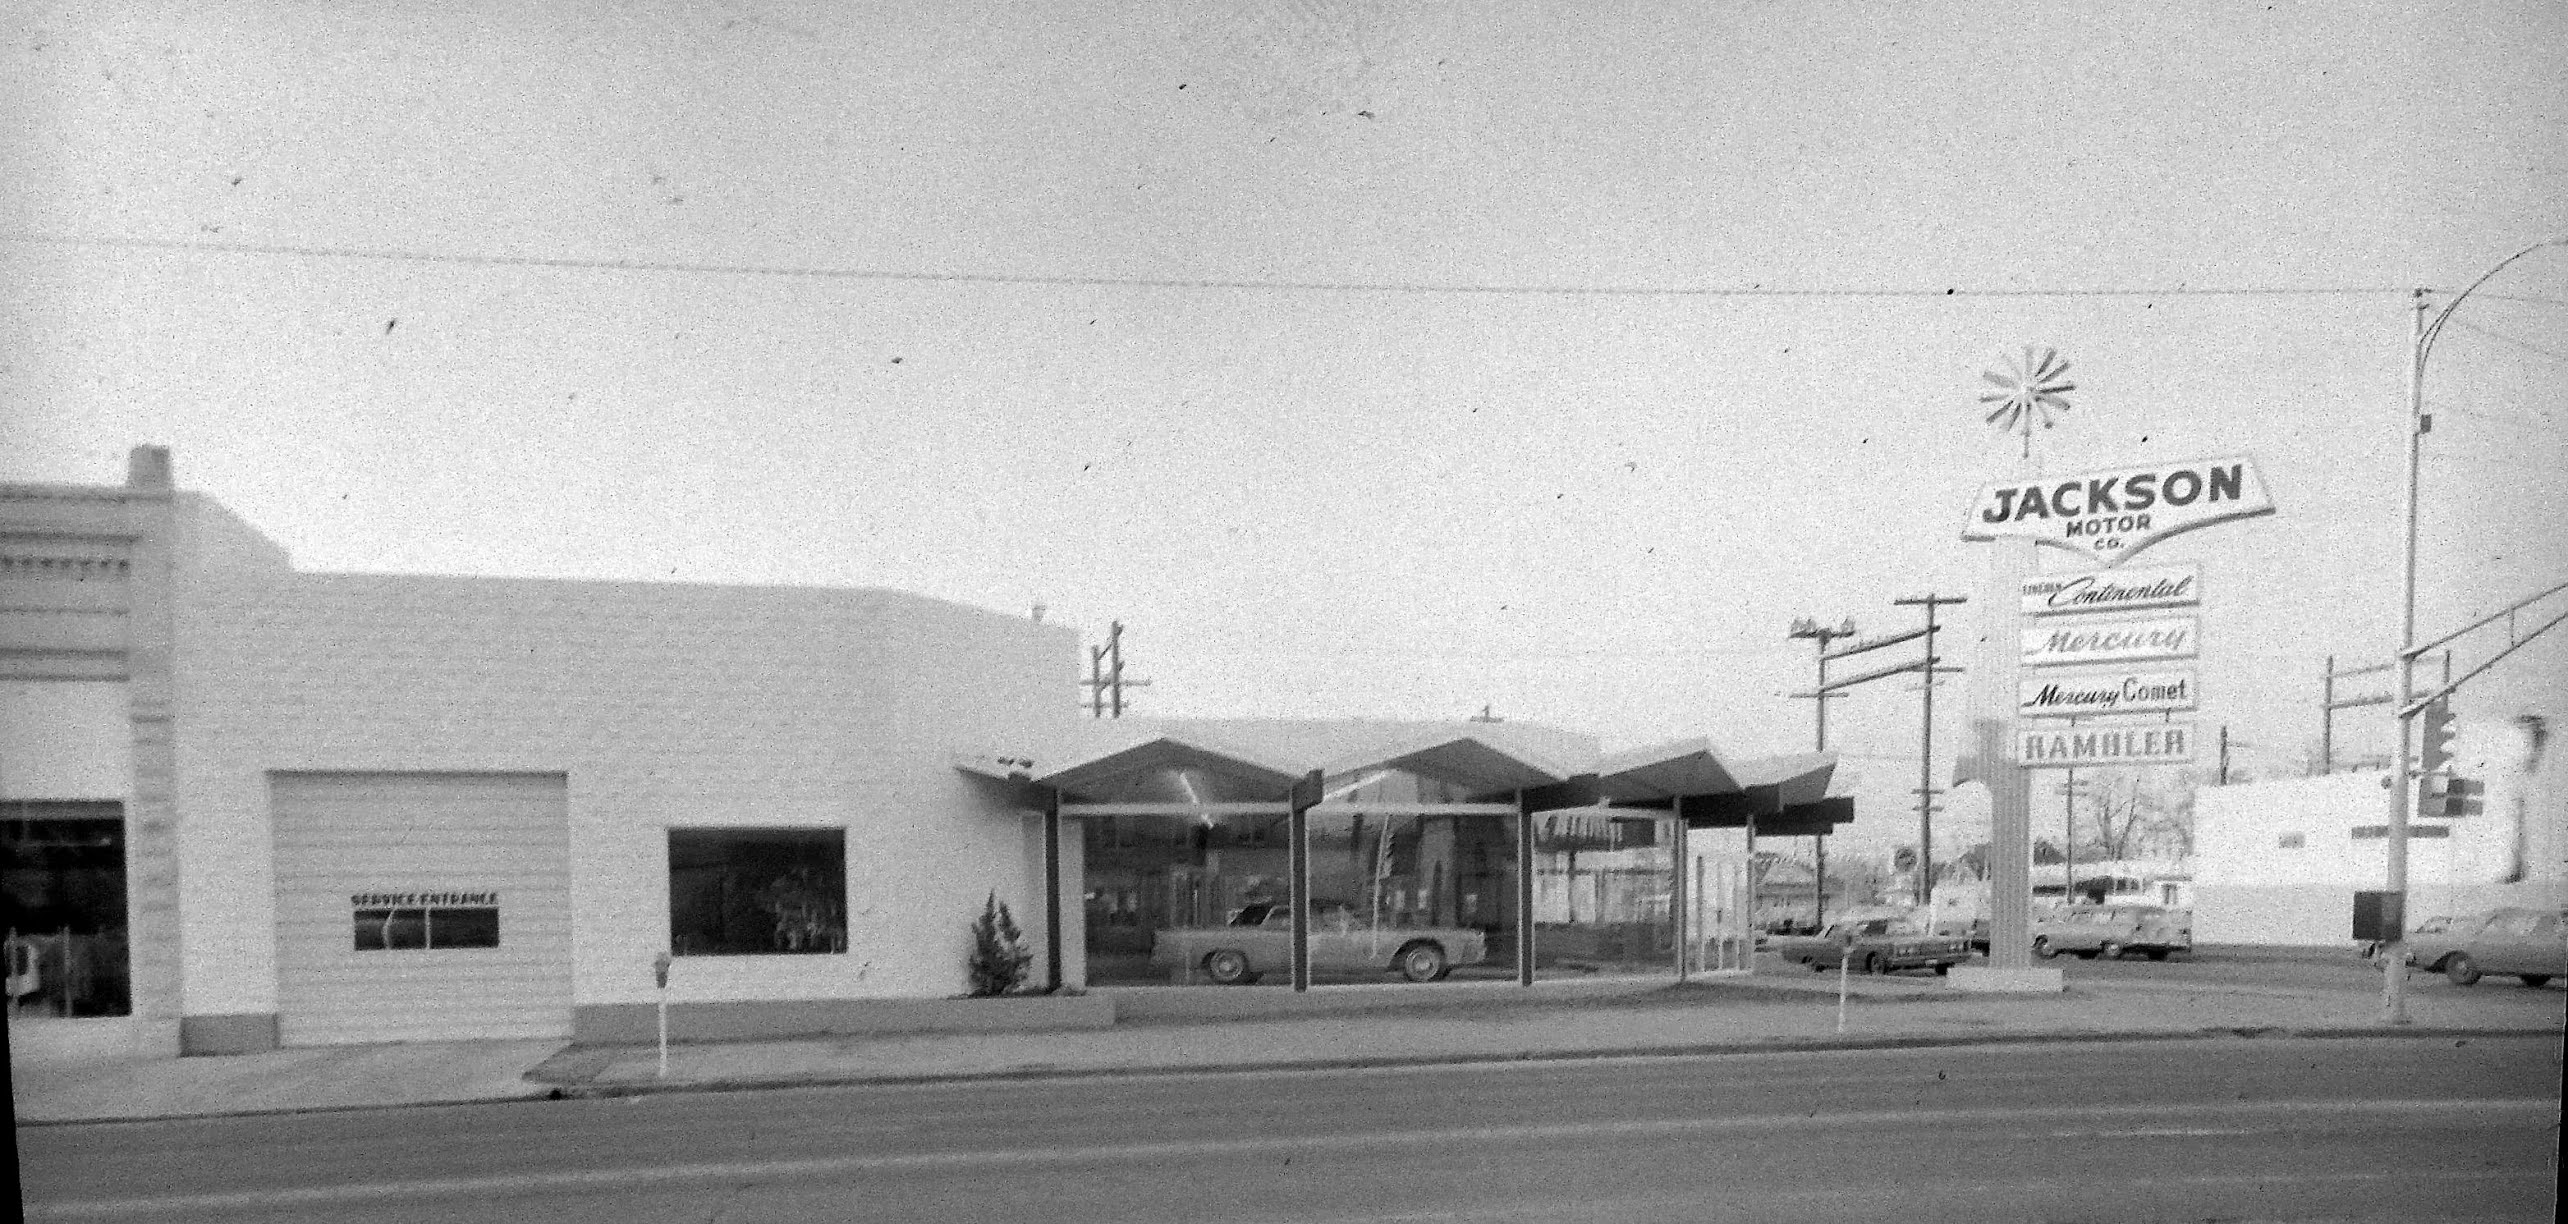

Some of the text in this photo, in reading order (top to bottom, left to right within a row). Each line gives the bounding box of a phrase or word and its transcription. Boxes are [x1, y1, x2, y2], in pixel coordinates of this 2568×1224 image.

[1982, 464, 2242, 523] JACKSON
[2066, 514, 2151, 538] MOTOR
[2094, 538, 2124, 550] CO.
[2048, 575, 2194, 607] Continental
[2023, 630, 2187, 655] Mercury
[2021, 677, 2187, 708] Mercury Comet
[2025, 729, 2184, 759] RAMBLER
[350, 892, 498, 906] SERVICE ENTRANCE
